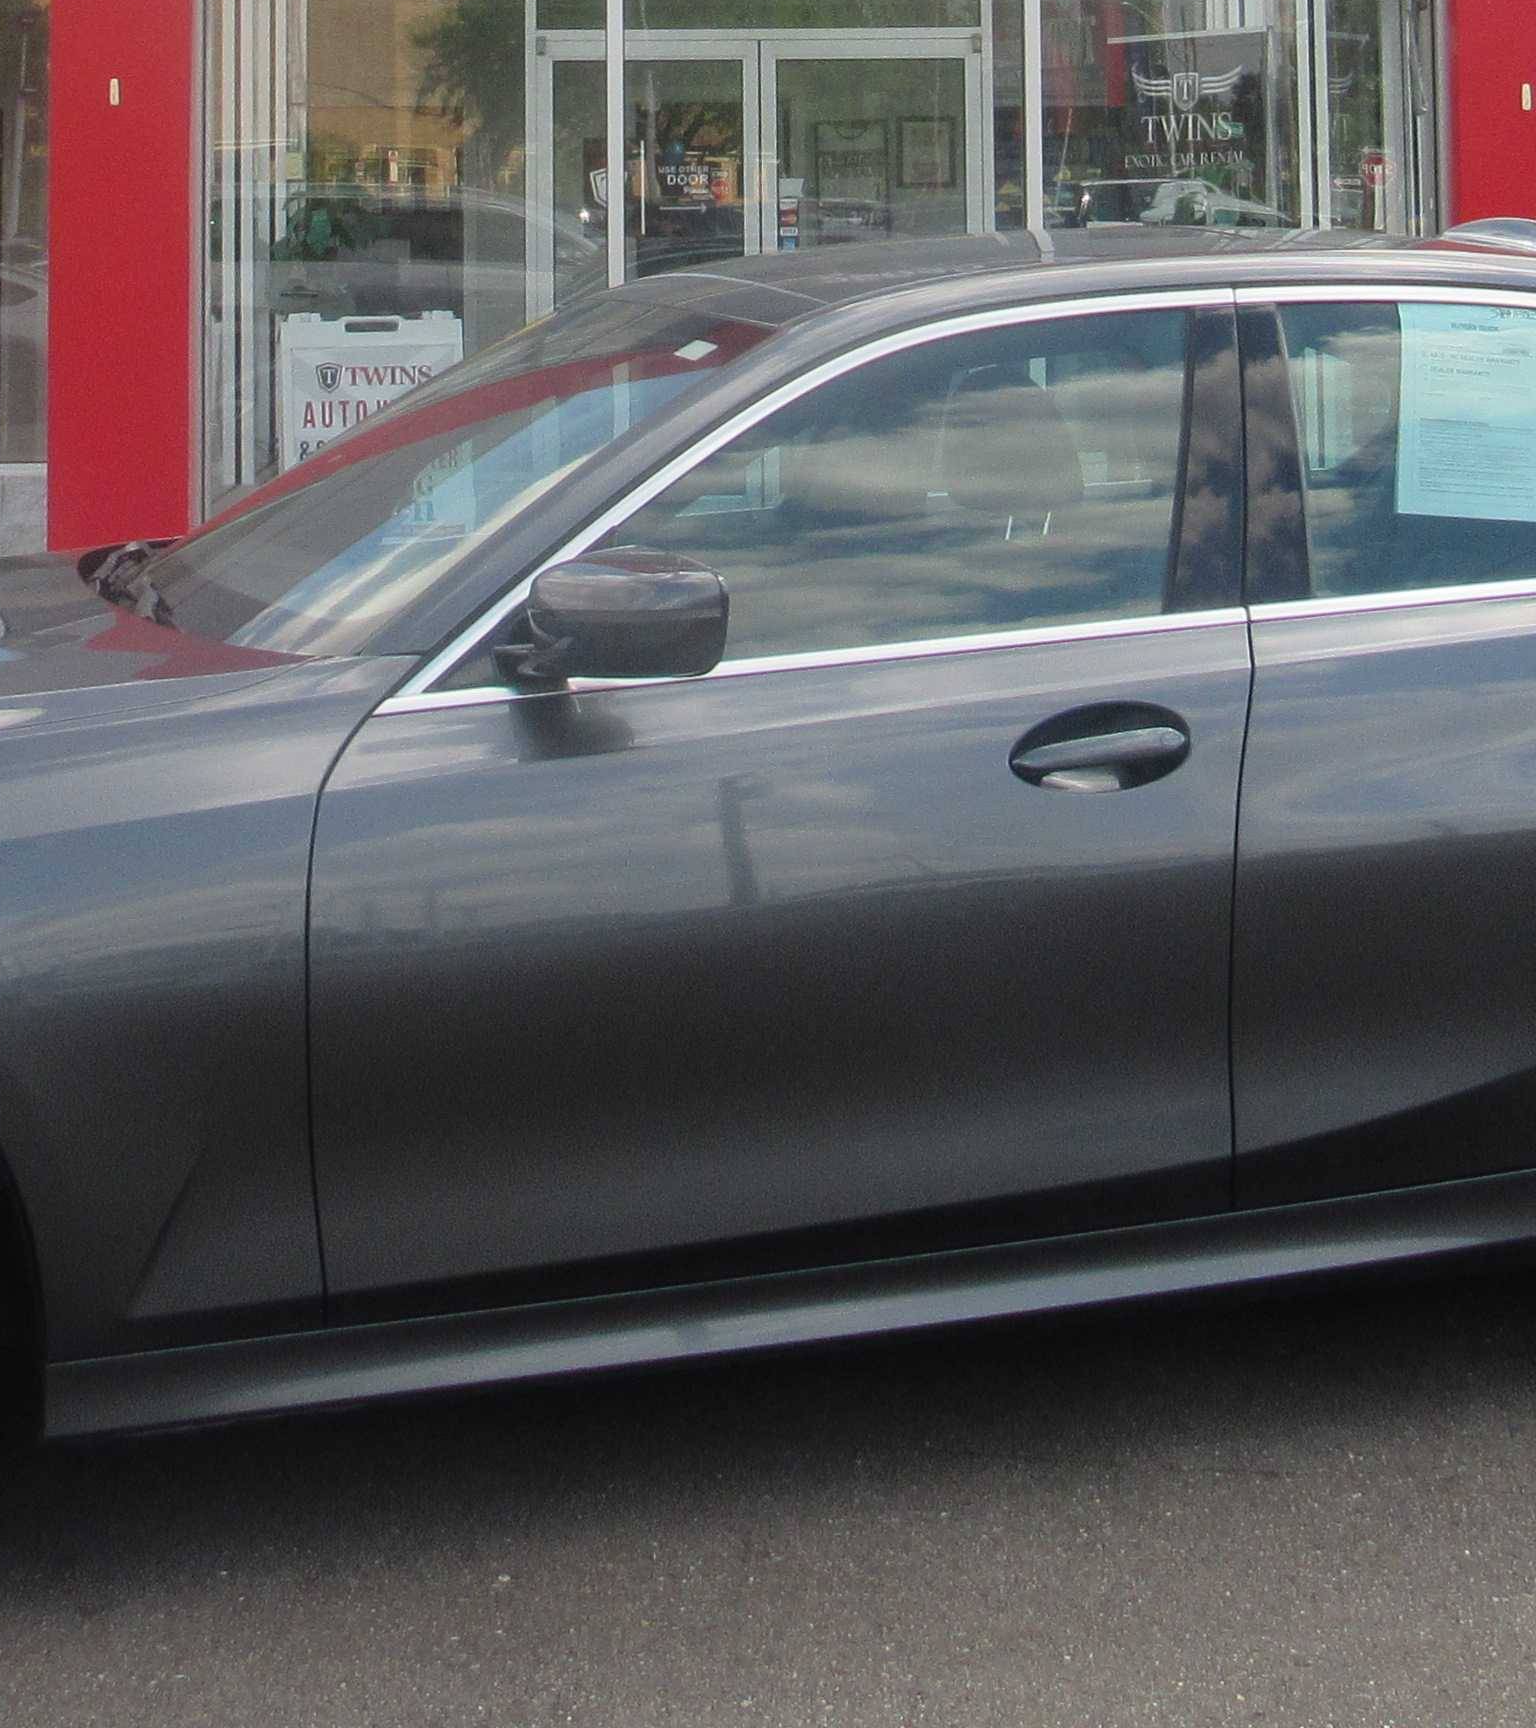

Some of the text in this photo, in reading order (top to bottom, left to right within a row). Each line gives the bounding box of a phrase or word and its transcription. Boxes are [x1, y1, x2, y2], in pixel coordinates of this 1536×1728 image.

[1140, 112, 1233, 145] TWINS
[1170, 153, 1195, 169] CAR
[1199, 150, 1248, 166] RENTAL
[667, 174, 710, 186] DOOR
[344, 365, 433, 387] TWINS
[302, 399, 368, 429] AUTO
